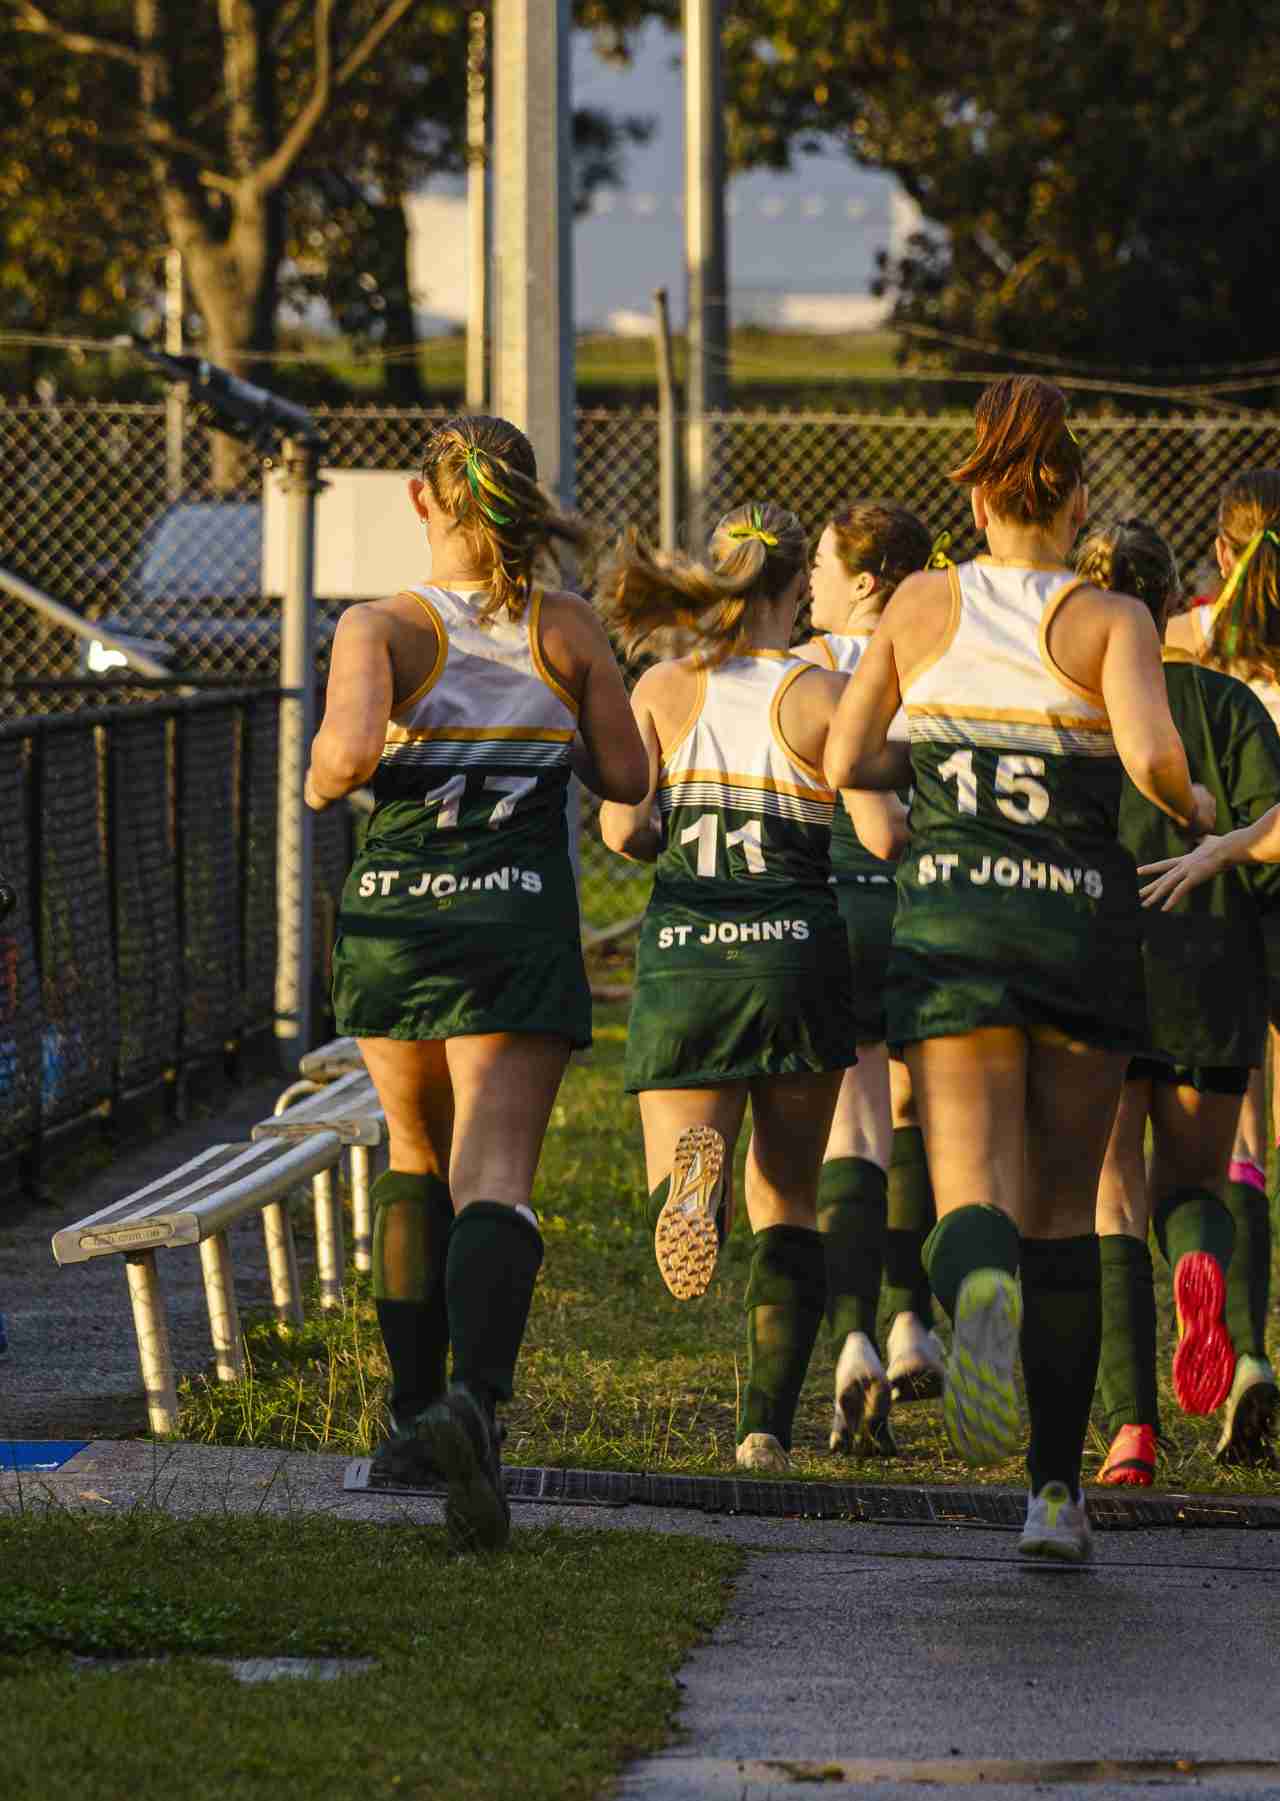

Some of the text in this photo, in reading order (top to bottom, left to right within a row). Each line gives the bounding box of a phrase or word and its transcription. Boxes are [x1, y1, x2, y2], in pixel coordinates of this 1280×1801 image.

[425, 774, 538, 829] 17
[938, 750, 1050, 825] 15
[681, 814, 767, 877] 11
[359, 870, 399, 897] ST
[918, 854, 1103, 899] ST JOHN'S
[658, 920, 809, 949] ST JOHN'S
